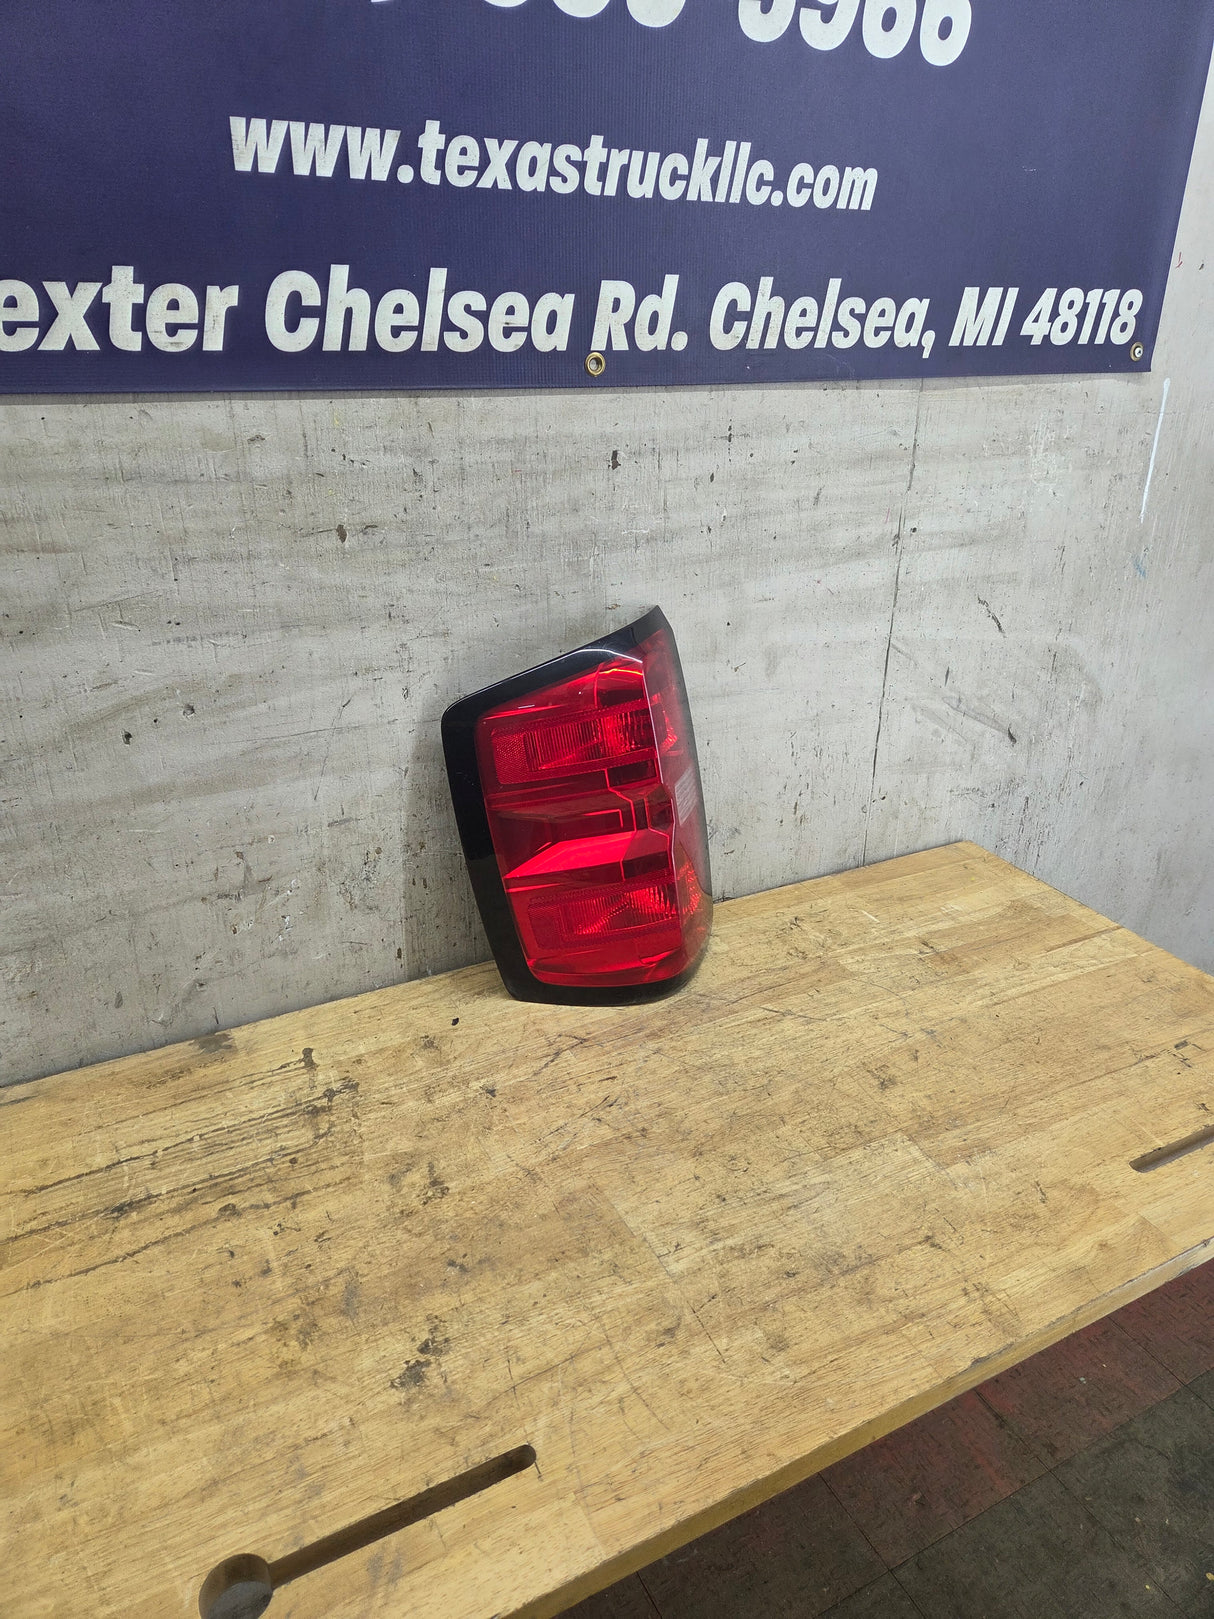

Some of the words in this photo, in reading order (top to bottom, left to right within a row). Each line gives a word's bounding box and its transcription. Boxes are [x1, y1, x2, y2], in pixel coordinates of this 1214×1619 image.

[229, 116, 879, 211] www.texastruckllc.com
[0, 265, 239, 353] exter
[264, 264, 576, 353] Chelsea
[590, 273, 689, 352] Rd.
[709, 276, 936, 359] Chelsea,
[948, 286, 1020, 347] MI
[1019, 287, 1144, 346] 48118
